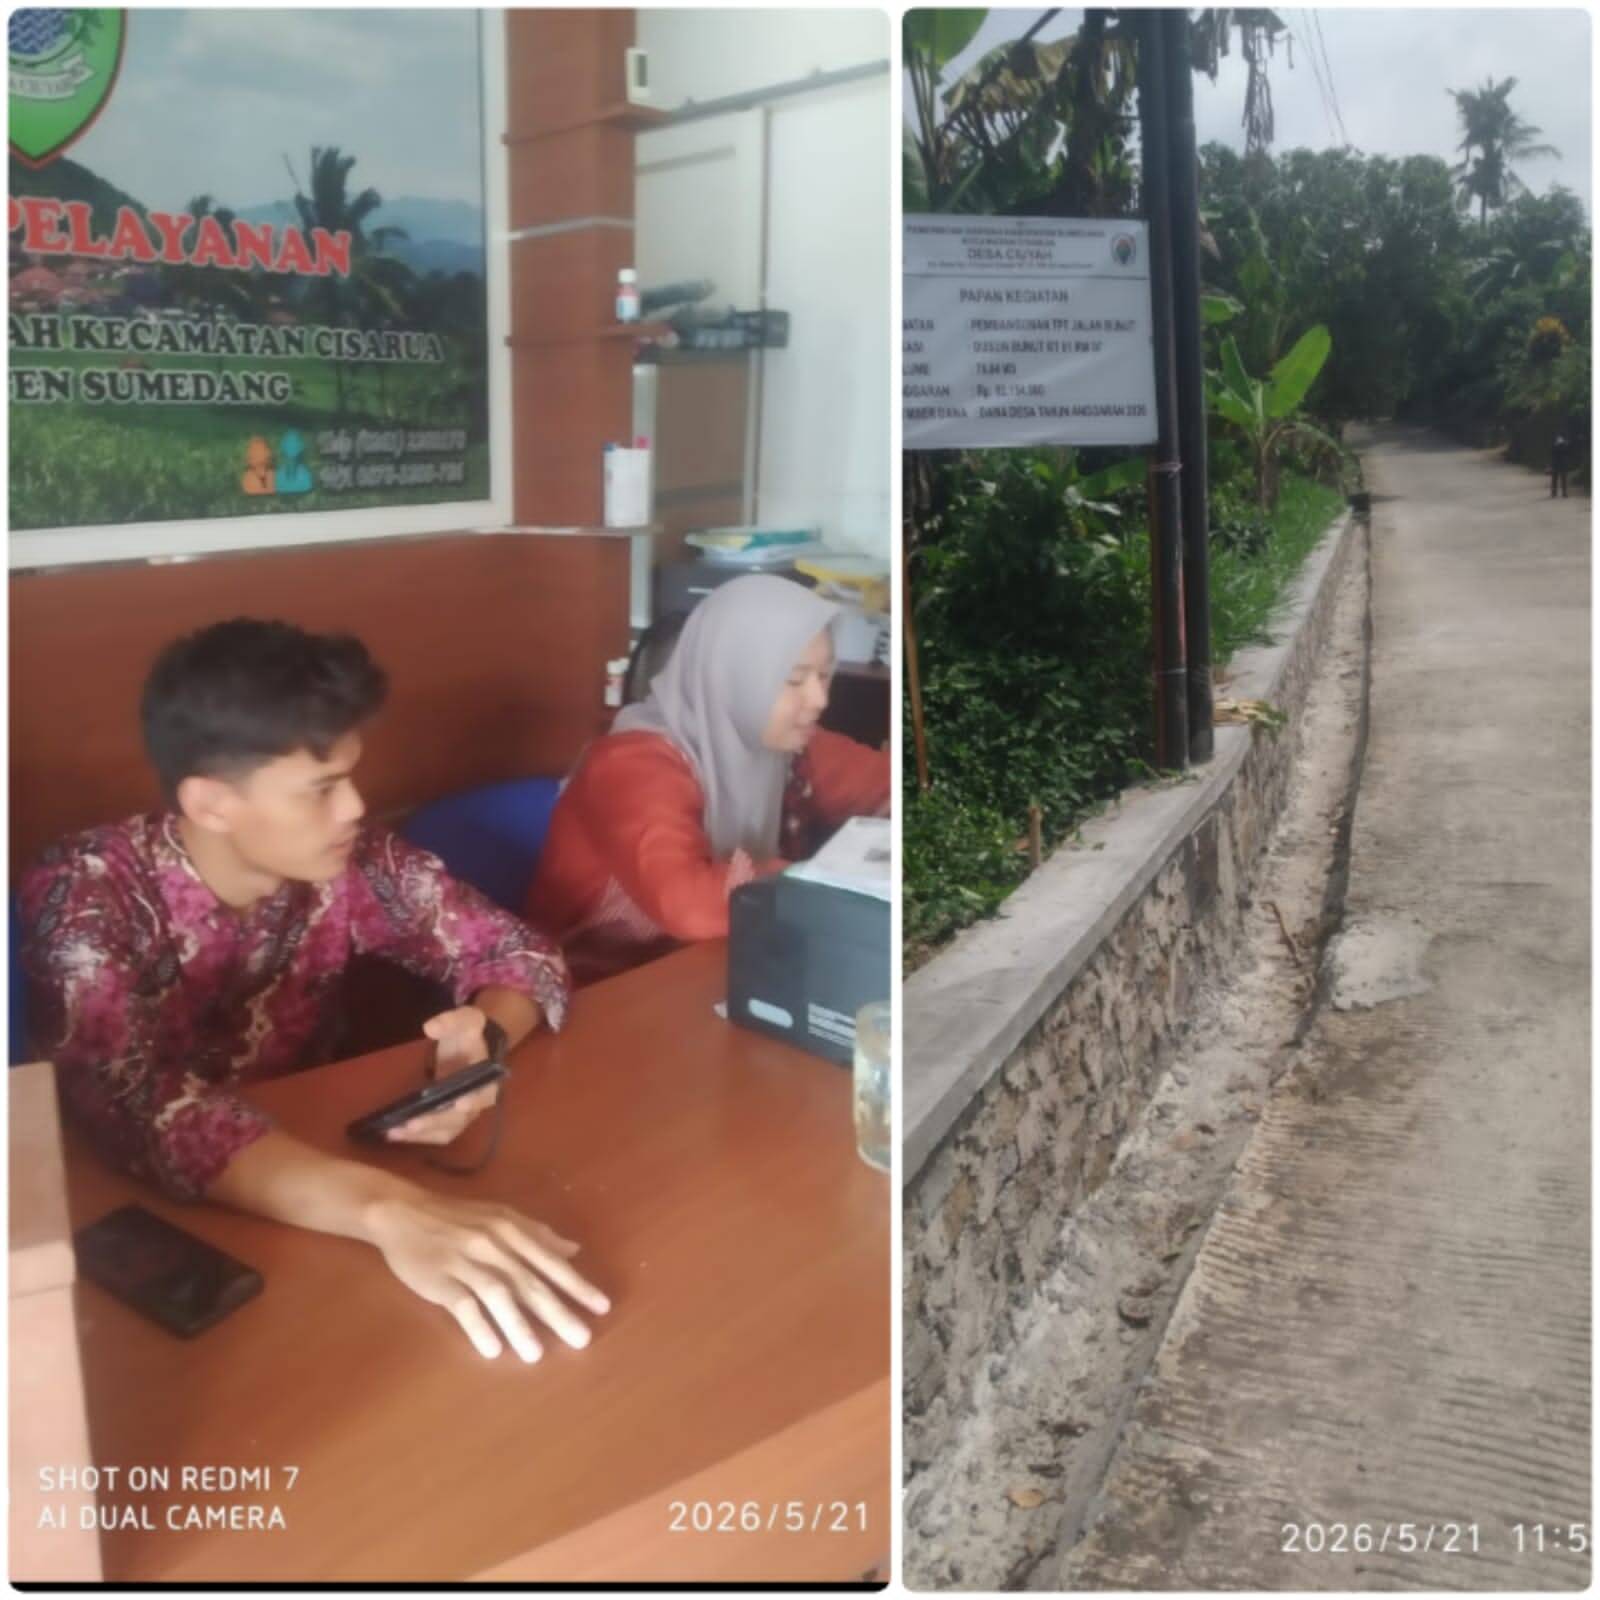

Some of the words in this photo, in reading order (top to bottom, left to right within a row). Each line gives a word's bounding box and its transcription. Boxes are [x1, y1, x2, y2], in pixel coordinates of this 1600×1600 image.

[959, 287, 1002, 304] PAPAN
[1005, 287, 1069, 304] KEGIATAN
[71, 316, 306, 356] KECAMATAN
[315, 331, 444, 361] CISARUA
[8, 371, 71, 400] EN
[83, 371, 290, 401] SUMEDANG
